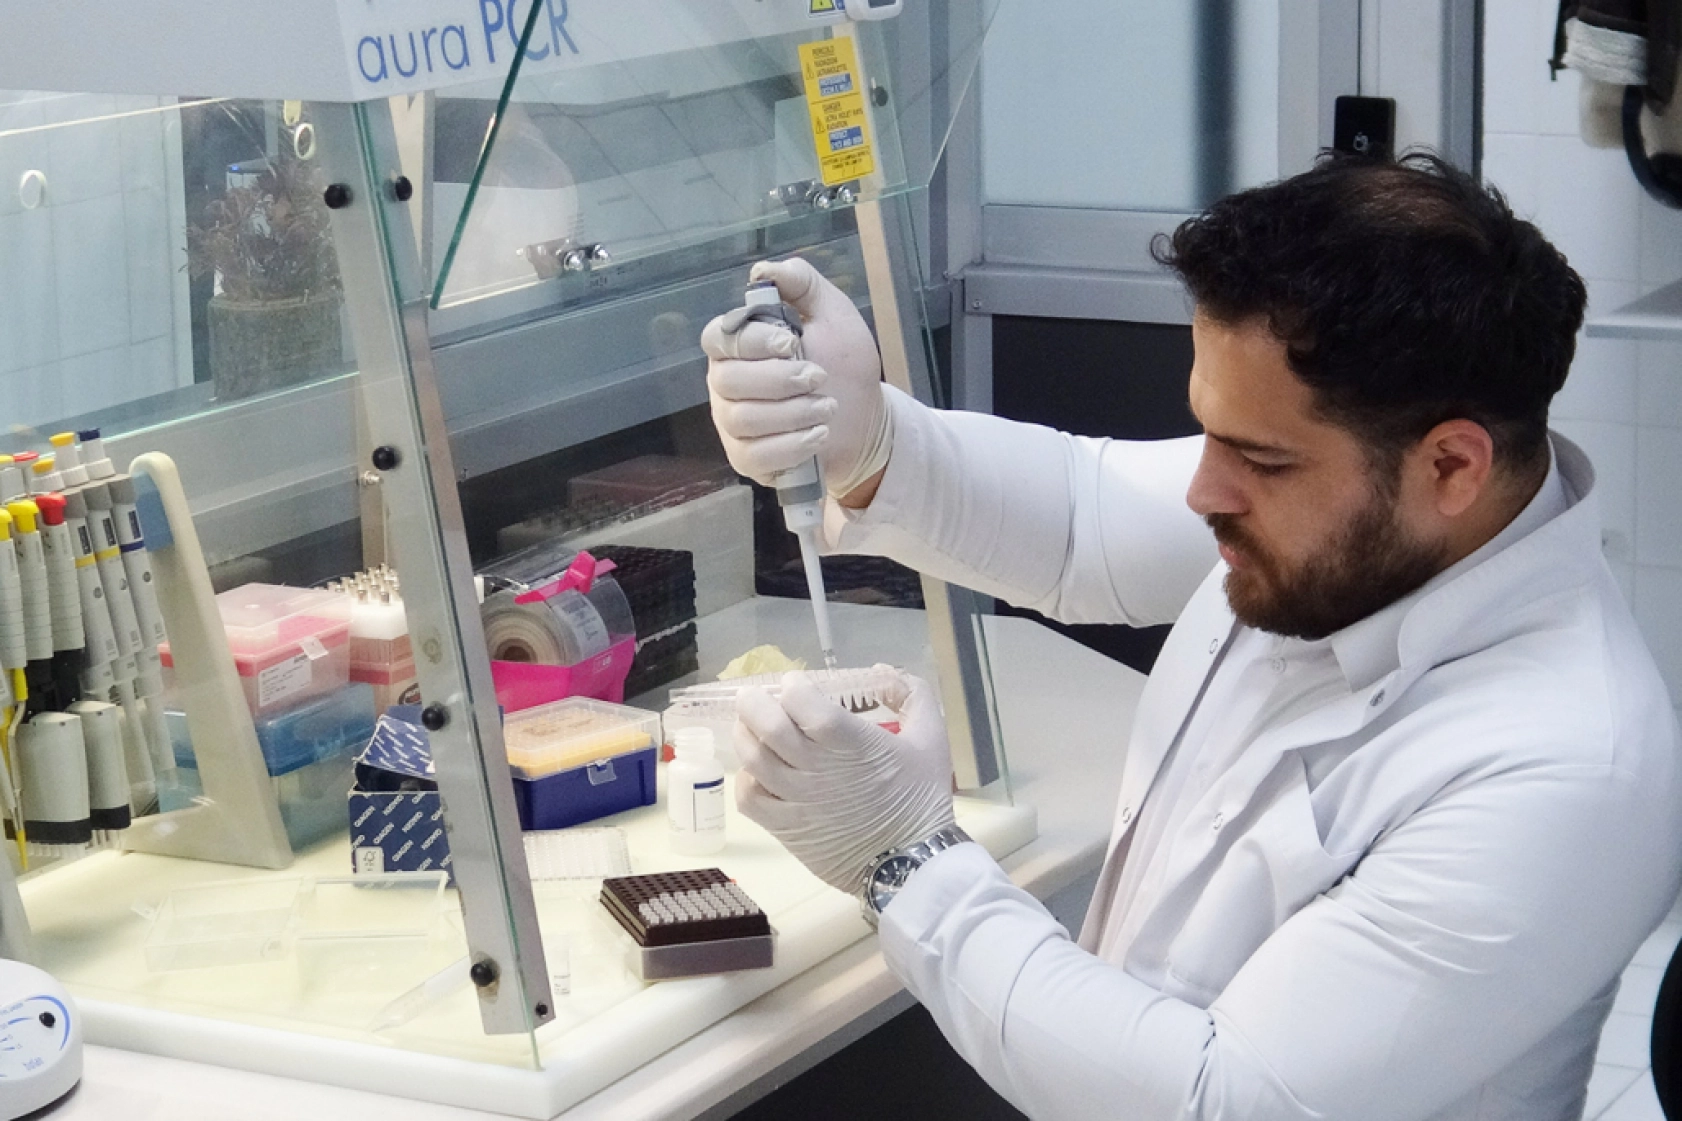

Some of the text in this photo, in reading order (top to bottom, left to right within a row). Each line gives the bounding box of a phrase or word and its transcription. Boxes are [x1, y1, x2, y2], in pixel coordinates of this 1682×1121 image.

[357, 0, 580, 83] aura PCR
[353, 805, 376, 828] QIAGEN
[401, 811, 423, 833] QIAGEN
[373, 822, 395, 845] QIAGEN
[421, 828, 443, 850] QIAGEN
[392, 839, 414, 862] QIAGEN
